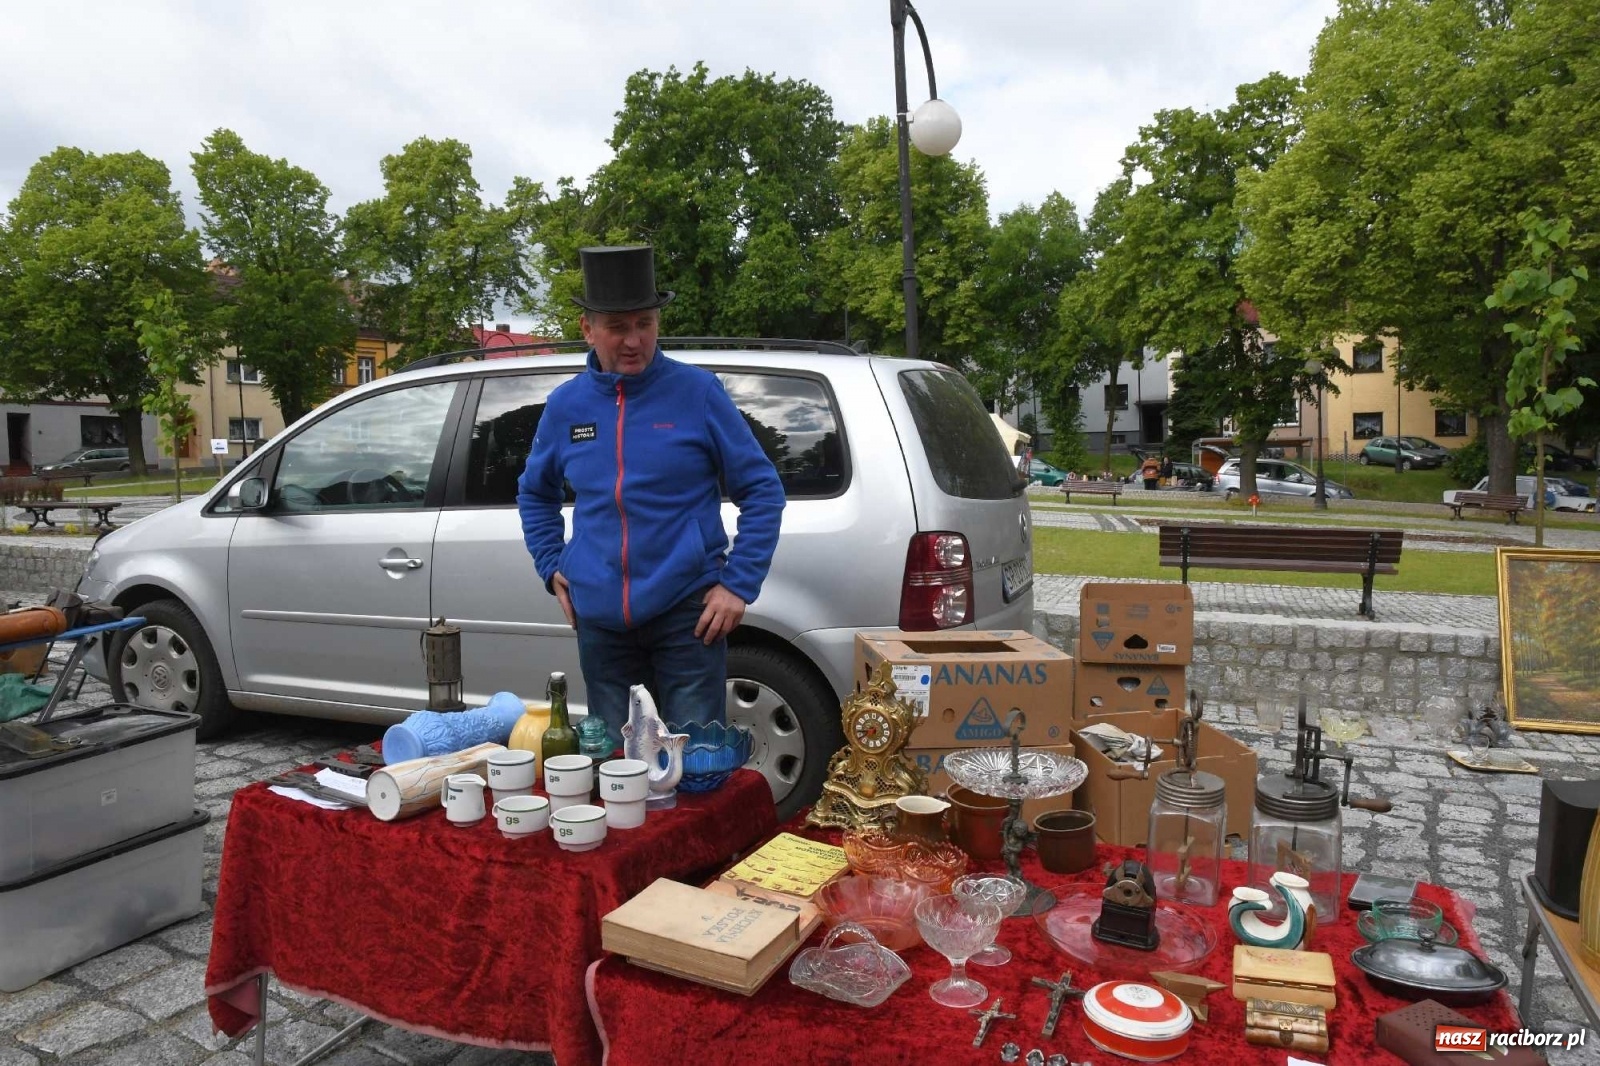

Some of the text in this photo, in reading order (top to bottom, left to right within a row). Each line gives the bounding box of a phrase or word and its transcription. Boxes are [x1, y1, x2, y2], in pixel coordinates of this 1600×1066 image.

[931, 663, 1048, 686] ANANAS
[490, 768, 501, 777] gs
[549, 774, 560, 783] gs
[610, 782, 624, 792] gs
[505, 815, 520, 826] gs
[559, 827, 573, 837] gs
[702, 907, 746, 937] POLSKA
[716, 908, 762, 943] KUCHNIA
